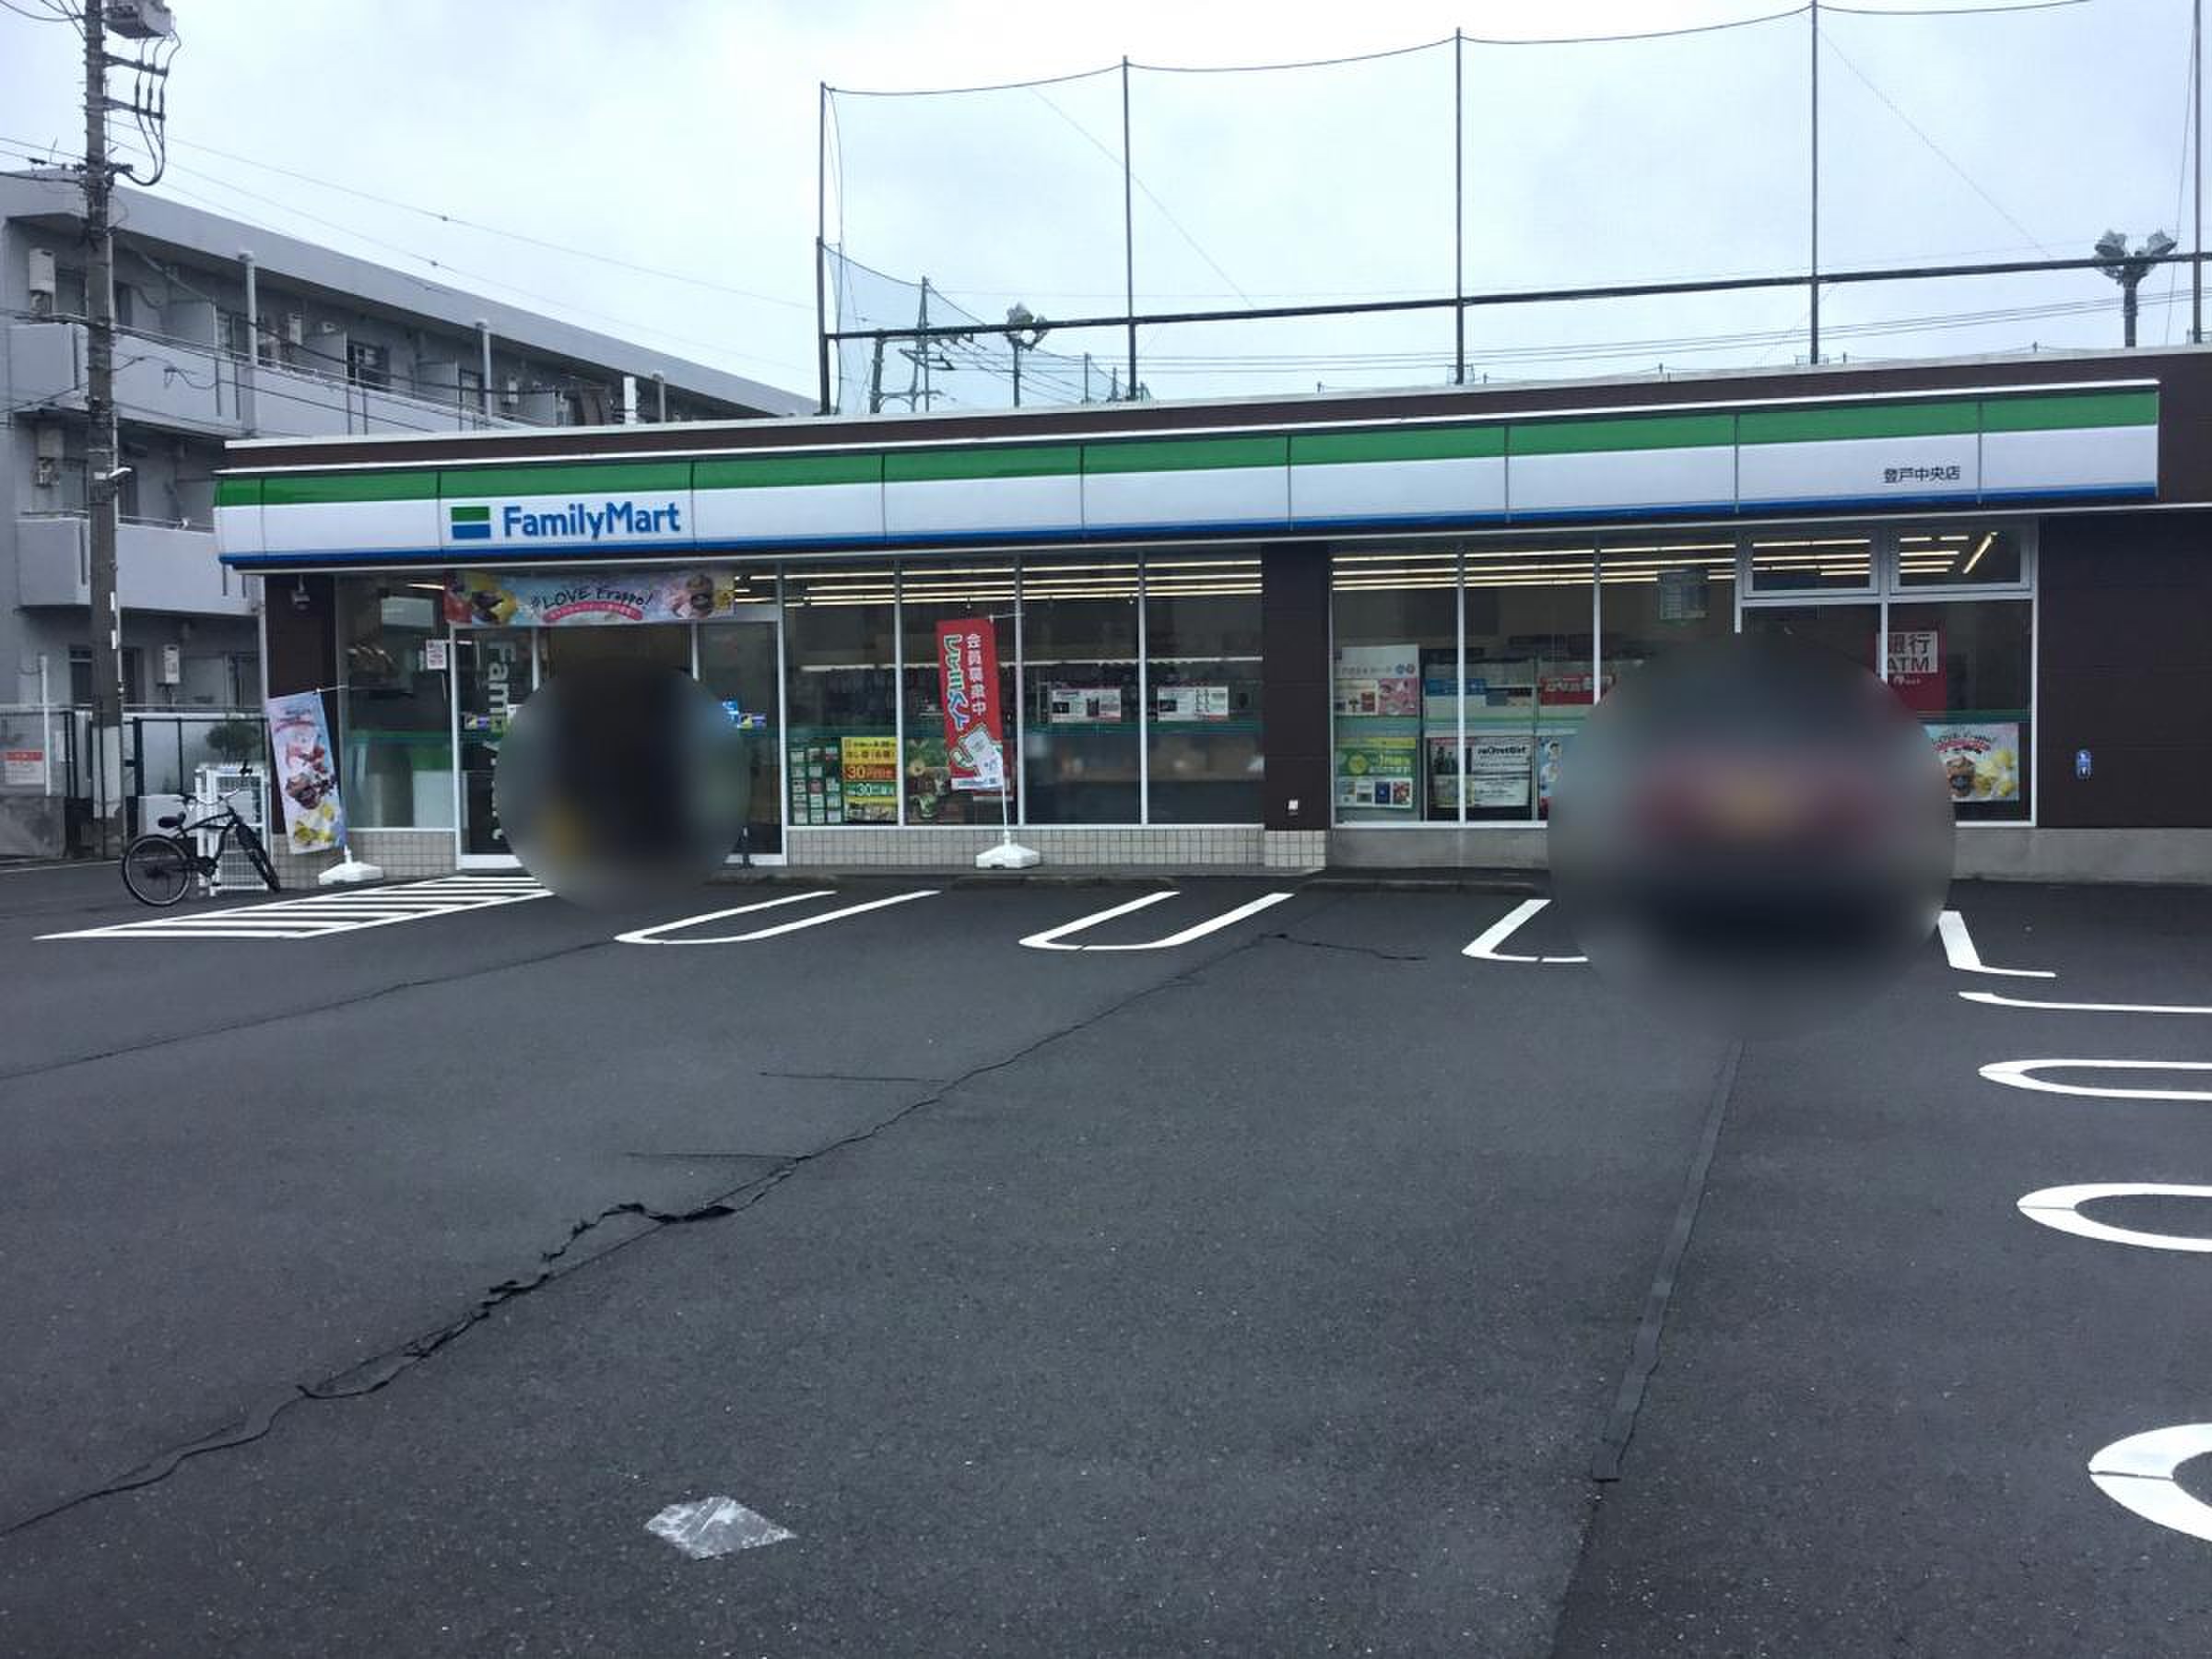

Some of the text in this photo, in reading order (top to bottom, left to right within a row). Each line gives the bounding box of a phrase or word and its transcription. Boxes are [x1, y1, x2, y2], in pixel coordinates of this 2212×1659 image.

[1884, 465, 1961, 483] 登戸中央店
[503, 501, 681, 540] FamilyMart
[1887, 656, 1930, 672] ATM
